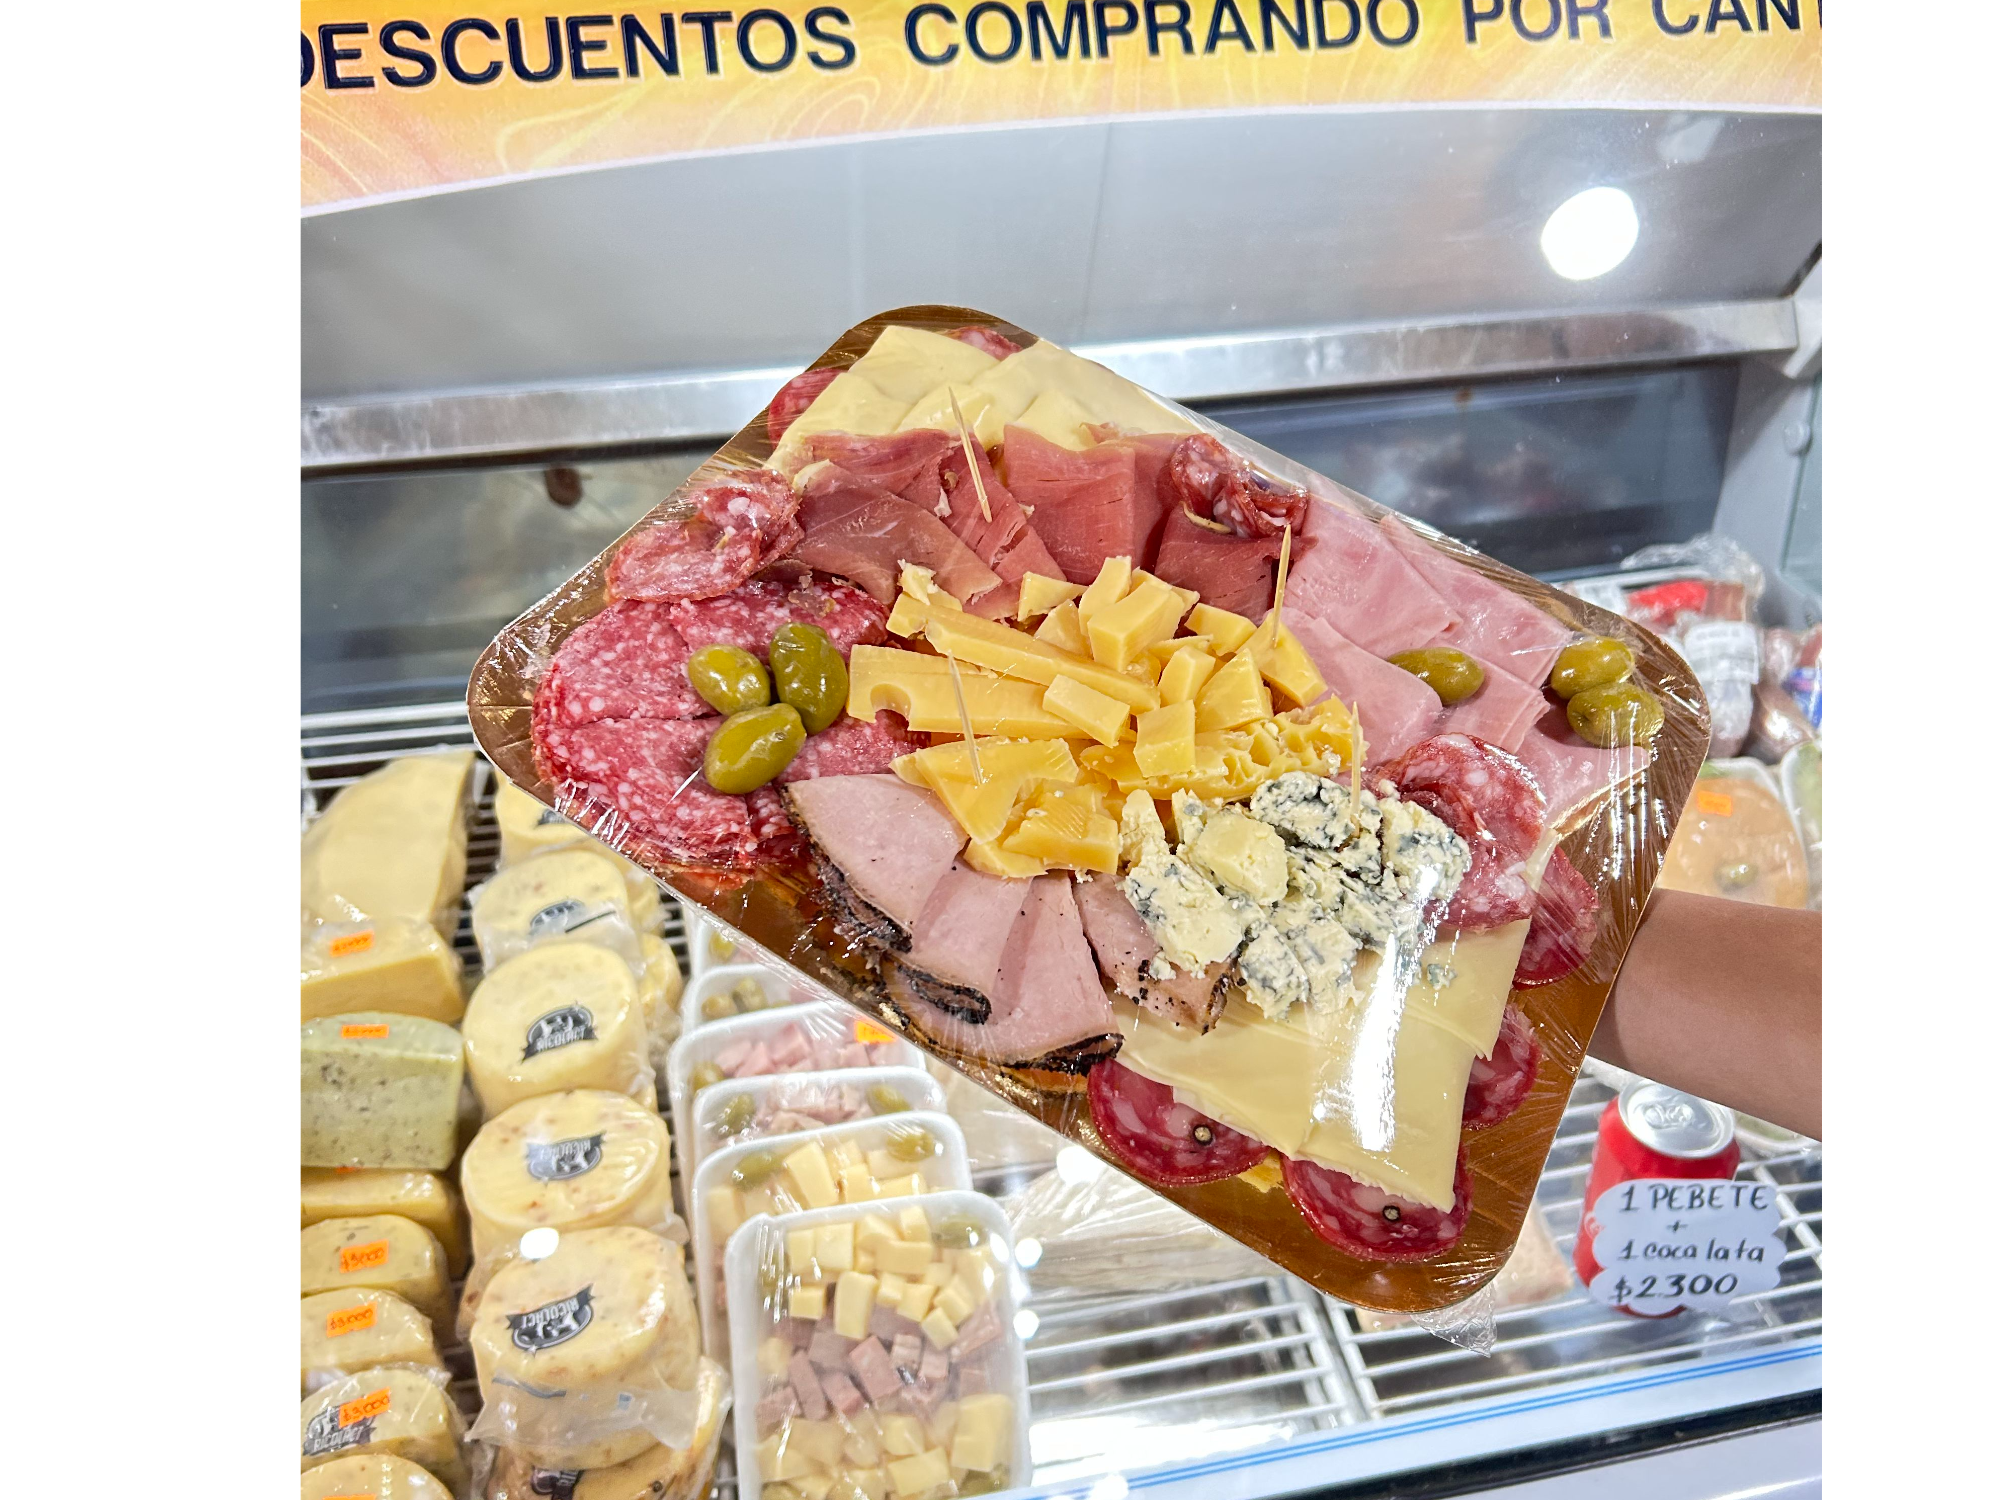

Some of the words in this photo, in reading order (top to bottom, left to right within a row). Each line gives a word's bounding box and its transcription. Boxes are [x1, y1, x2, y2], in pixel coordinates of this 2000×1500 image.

[300, 6, 857, 90] ESCUENTOS
[905, 0, 1420, 67] COMPRANDO
[1464, 0, 1613, 43] POR
[1652, 0, 1822, 36] CAN
[1620, 1184, 1640, 1212] 1
[1649, 1183, 1769, 1210] PEBETE
[1666, 1220, 1688, 1233] +
[1617, 1240, 1640, 1260] 1
[1644, 1243, 1698, 1259] coca
[1708, 1238, 1765, 1262] lata
[1609, 1273, 1738, 1303] $2300
[520, 1297, 580, 1329] RICOLACT
